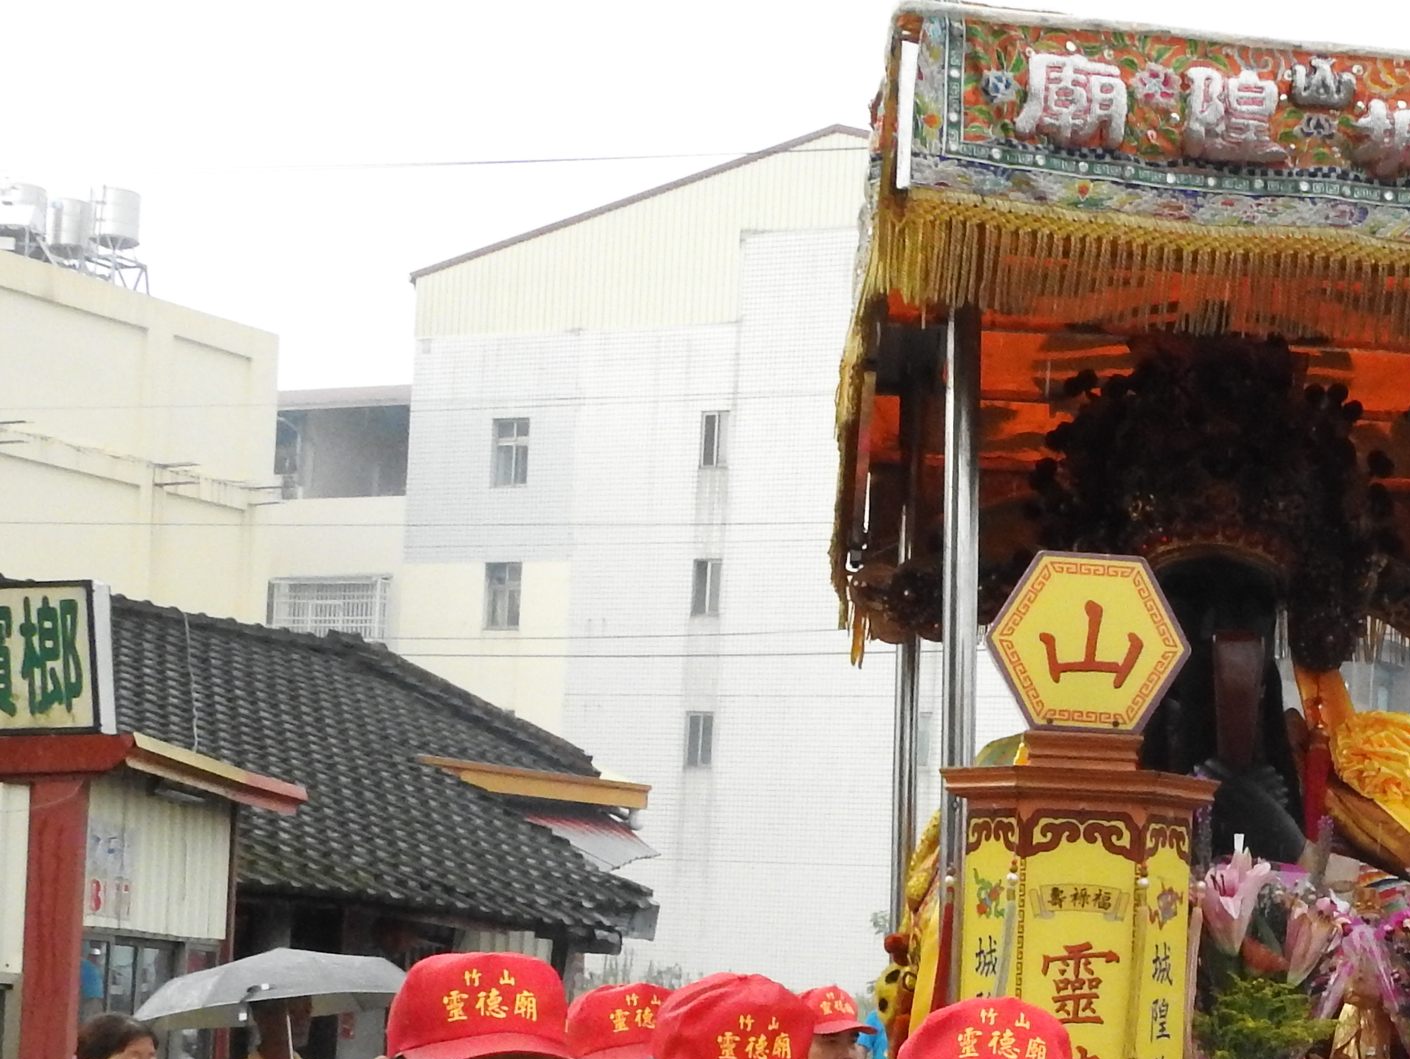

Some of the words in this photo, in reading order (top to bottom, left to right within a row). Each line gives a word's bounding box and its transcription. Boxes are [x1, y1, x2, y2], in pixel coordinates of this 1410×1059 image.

[1039, 600, 1144, 689] 山
[464, 968, 516, 987] 竹山
[442, 987, 538, 1022] 靈德廟
[625, 993, 662, 1007] 竹山
[738, 1013, 780, 1032] 竹山
[980, 1007, 1031, 1030] 竹山
